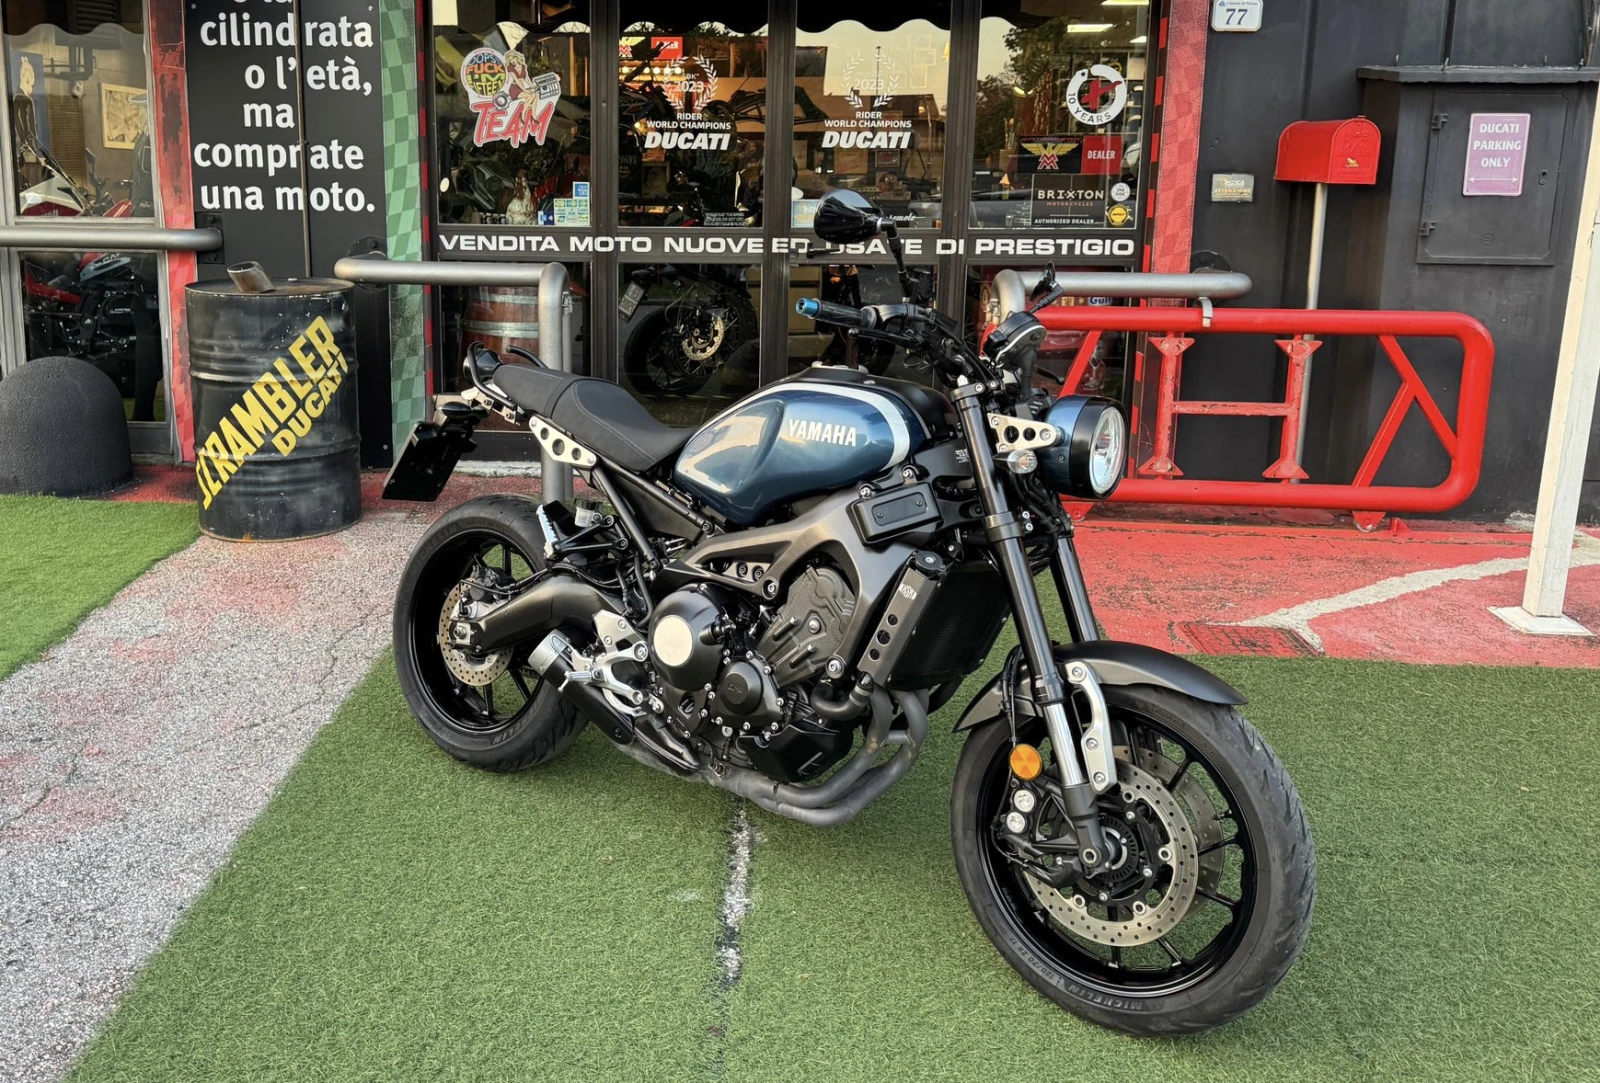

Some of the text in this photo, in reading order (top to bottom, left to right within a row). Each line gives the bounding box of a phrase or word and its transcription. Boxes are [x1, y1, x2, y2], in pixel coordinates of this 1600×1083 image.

[1226, 9, 1247, 25] 77
[200, 12, 374, 47] cilindrata
[245, 65, 265, 89] o
[467, 63, 505, 74] FUCK
[674, 81, 704, 92] 2023
[853, 79, 885, 91] 2023
[243, 103, 295, 128] ma
[677, 112, 703, 120] RIDER
[855, 111, 882, 119] RIDER
[1068, 92, 1112, 123] 10 YEARS
[471, 101, 553, 147] TEAM
[647, 121, 731, 130] WORLD CHAMPIONS
[824, 120, 912, 128] WORLD CHAMPIONS
[1479, 123, 1519, 133] DUCATI
[644, 132, 731, 150] DUCATI
[821, 131, 911, 149] DUCATI
[1473, 140, 1521, 150] PARKING
[194, 139, 364, 177] comprate
[1087, 150, 1116, 159] DEALER
[1481, 157, 1510, 168] ONLY
[201, 182, 375, 212] una moto.
[1037, 190, 1104, 200] BRIXTON
[439, 234, 1135, 255] VENDITA MOTO NUOVE ED USAE DI PRESTIGIO
[271, 351, 349, 457] DUCATI
[788, 418, 857, 447] YAMAHA
[1017, 946, 1028, 957] ZR
[1028, 957, 1054, 979] 120/70
[1068, 985, 1142, 1010] MICHELIN
